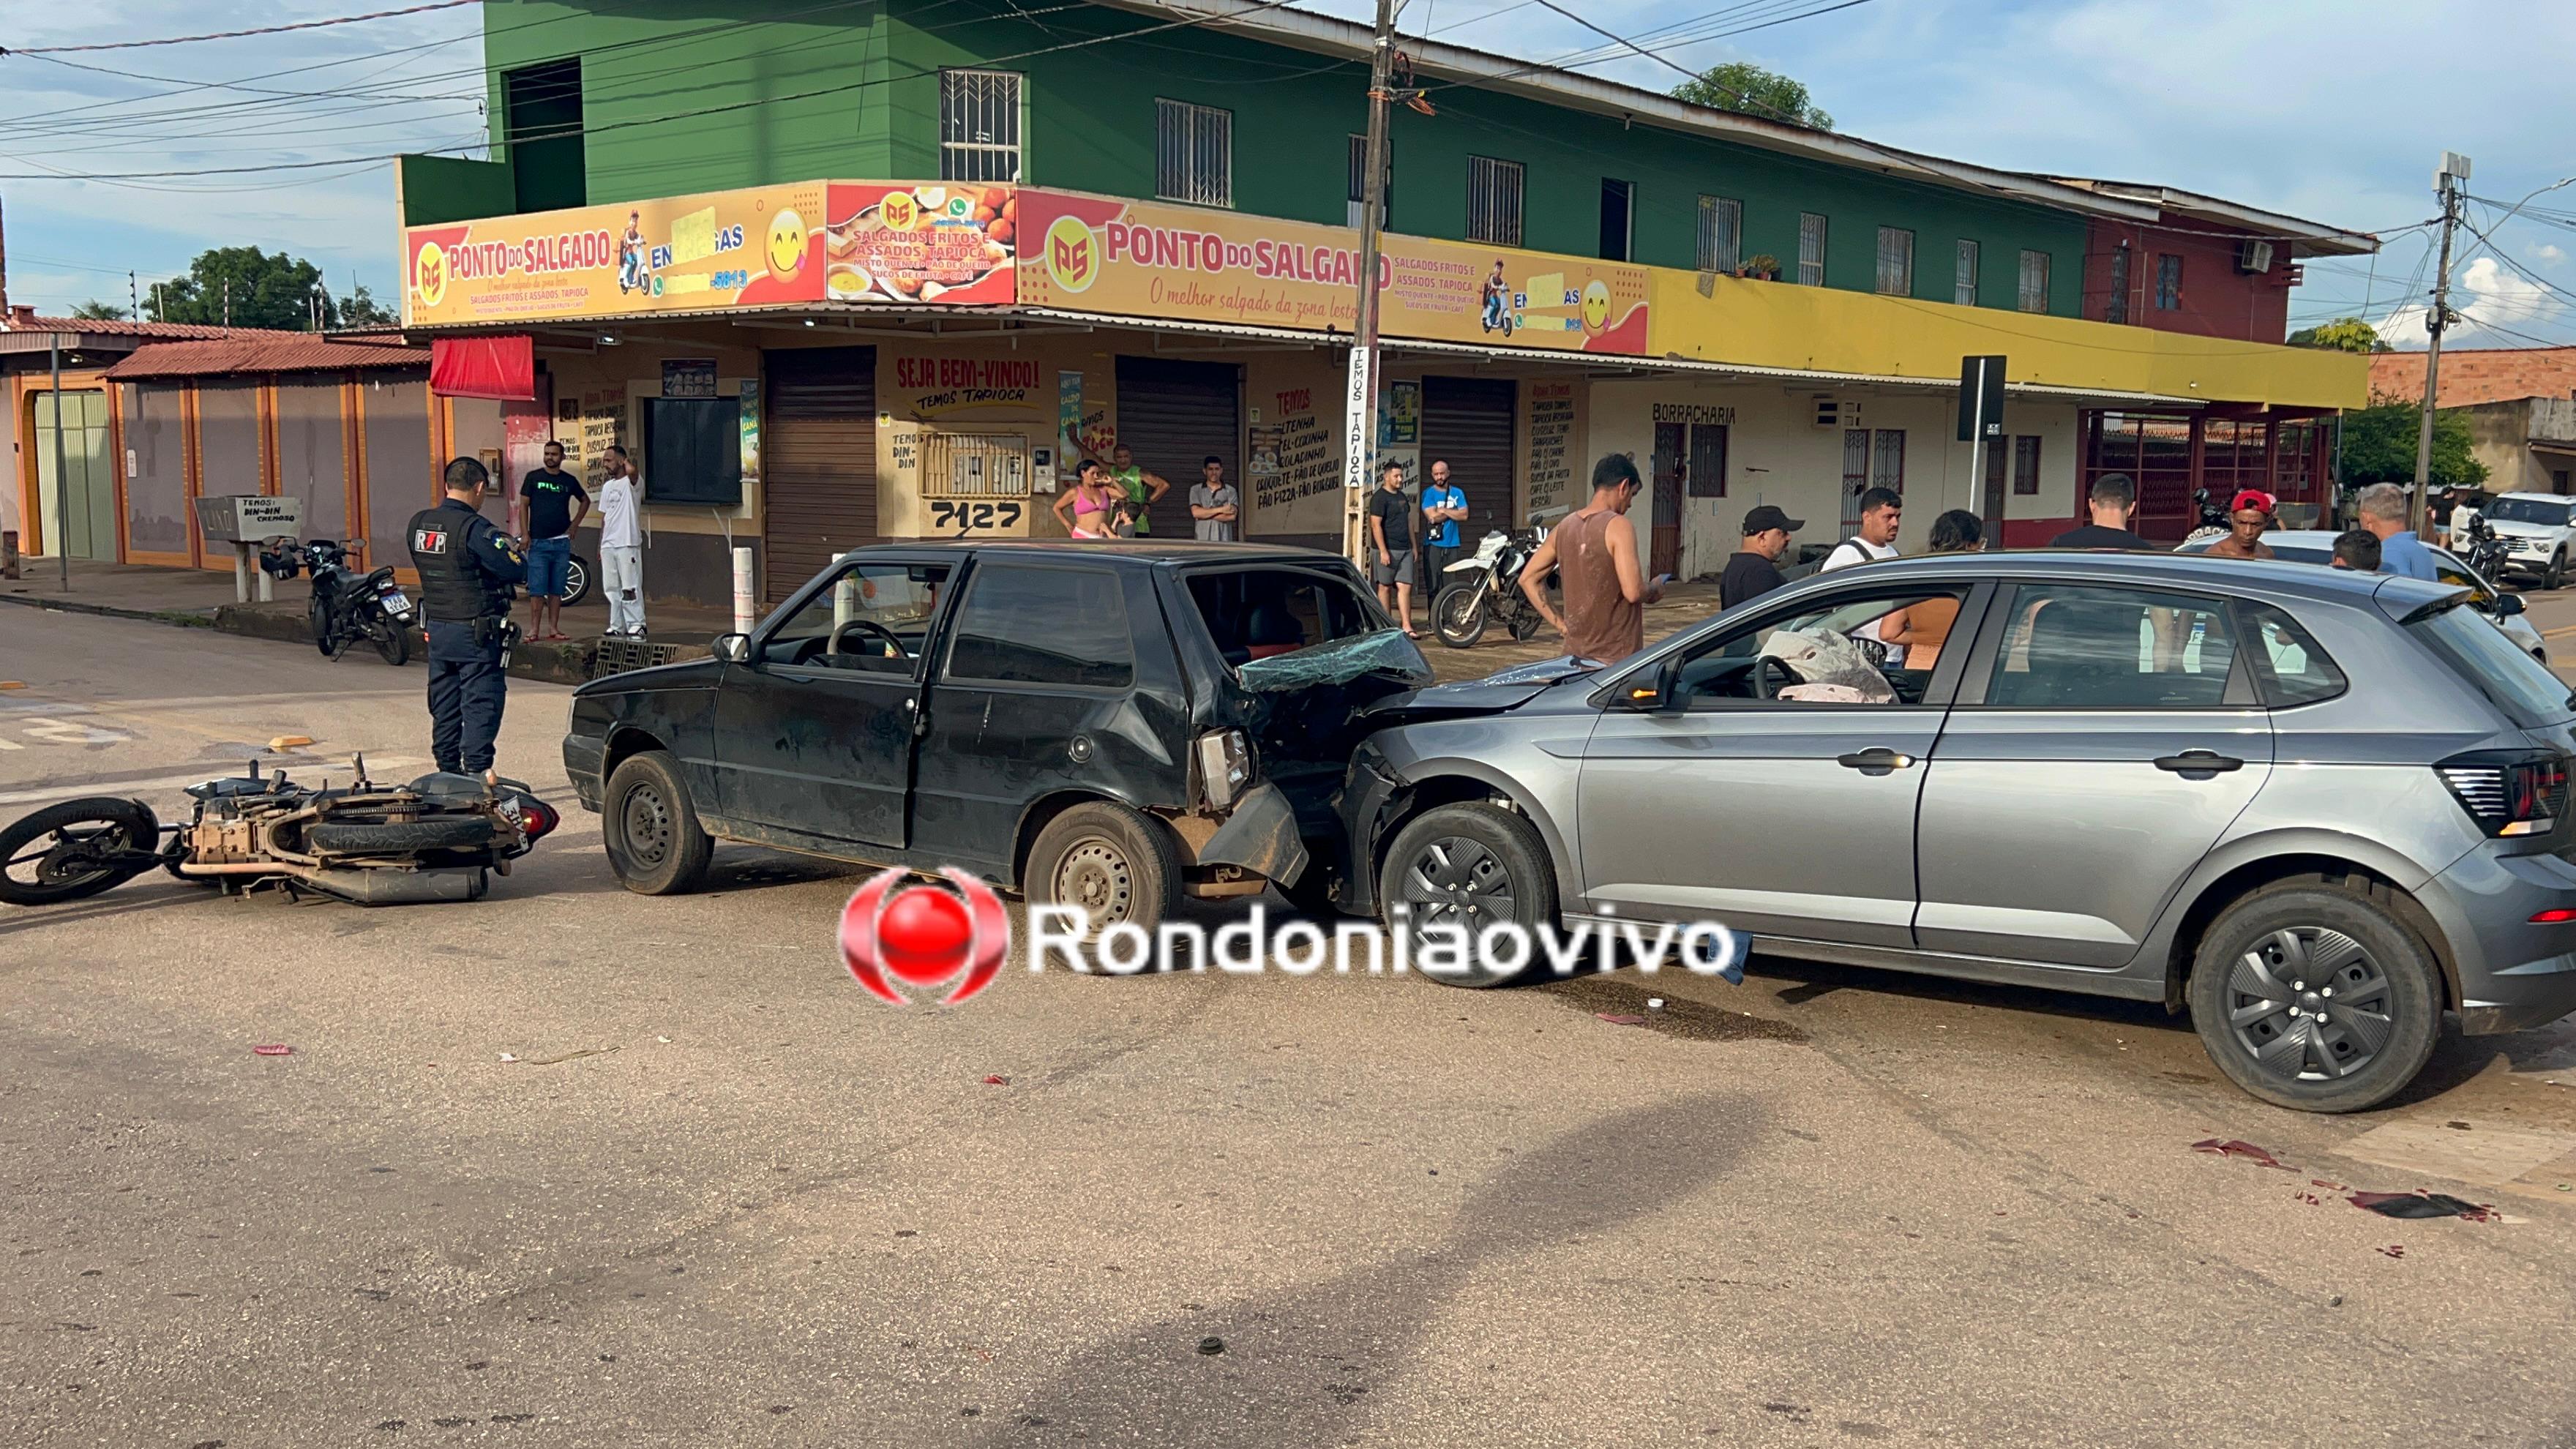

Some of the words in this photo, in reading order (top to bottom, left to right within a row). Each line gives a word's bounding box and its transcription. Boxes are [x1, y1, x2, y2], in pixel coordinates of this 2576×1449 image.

[853, 231, 926, 243] SALGADOS
[929, 233, 979, 244] FRITOS
[983, 233, 990, 244] E
[449, 242, 507, 280] PONTO
[509, 247, 523, 268] DO
[524, 231, 610, 273] SALGADO
[856, 245, 925, 258] ASSADOS,
[929, 246, 987, 259] TAPIOCA
[1107, 224, 1224, 272] PONTO
[1227, 245, 1252, 268] DO
[853, 259, 882, 267] MISTO
[884, 260, 921, 269] QUENTE
[926, 258, 945, 269] PÃO
[959, 261, 990, 269] QUEIJO
[1394, 257, 1439, 272] SALGADOS
[1440, 263, 1469, 276] FRITOS
[1470, 266, 1475, 276] E
[872, 270, 900, 279] SUCOS
[915, 272, 943, 280] FRUTA
[950, 270, 973, 281] CAFÉ
[1439, 279, 1473, 292] TAPIOCA
[471, 292, 501, 305] SALGADOS
[501, 291, 523, 302] FRITOS
[524, 290, 528, 301] E
[562, 287, 588, 299] TAPIOCA
[1150, 277, 1164, 304] O
[1167, 282, 1216, 307] melhor
[1219, 286, 1273, 318] salgado
[1276, 291, 1293, 315] da
[1296, 300, 1326, 322] zona
[1330, 296, 1359, 320] leste
[1456, 296, 1475, 304] QUEIJO
[1405, 301, 1422, 310] SUCOS
[1431, 303, 1448, 311] FRUTA
[897, 358, 937, 388] SEJA
[940, 358, 1040, 389] BEM-VINDO!
[1352, 349, 1363, 402] TEMOS
[916, 390, 957, 410] TEMOS
[962, 389, 1025, 402] TAPIOCA
[1061, 392, 1080, 405] CALDO
[1276, 389, 1311, 416] TEMOS
[1652, 402, 1736, 426] BORRACHARIA
[743, 419, 757, 432] CANA
[893, 434, 924, 445] TEMOS
[1295, 430, 1329, 450] COXINHA
[1349, 412, 1361, 487] TAPIOCA
[898, 457, 916, 469] DIN
[1549, 459, 1560, 468] OVO
[1257, 471, 1291, 493] CROQUETE
[1294, 465, 1308, 482] PÃO
[1309, 463, 1317, 478] DE
[1318, 458, 1340, 476] QUEIJO
[1554, 468, 1570, 479] FRUTA
[1549, 481, 1565, 492] LEITE
[1258, 492, 1273, 510] PÃO
[1274, 488, 1296, 505] PIZZA
[1298, 482, 1311, 498] PÃO
[244, 506, 281, 516] DIN-DIN
[931, 502, 1022, 529] 7127
